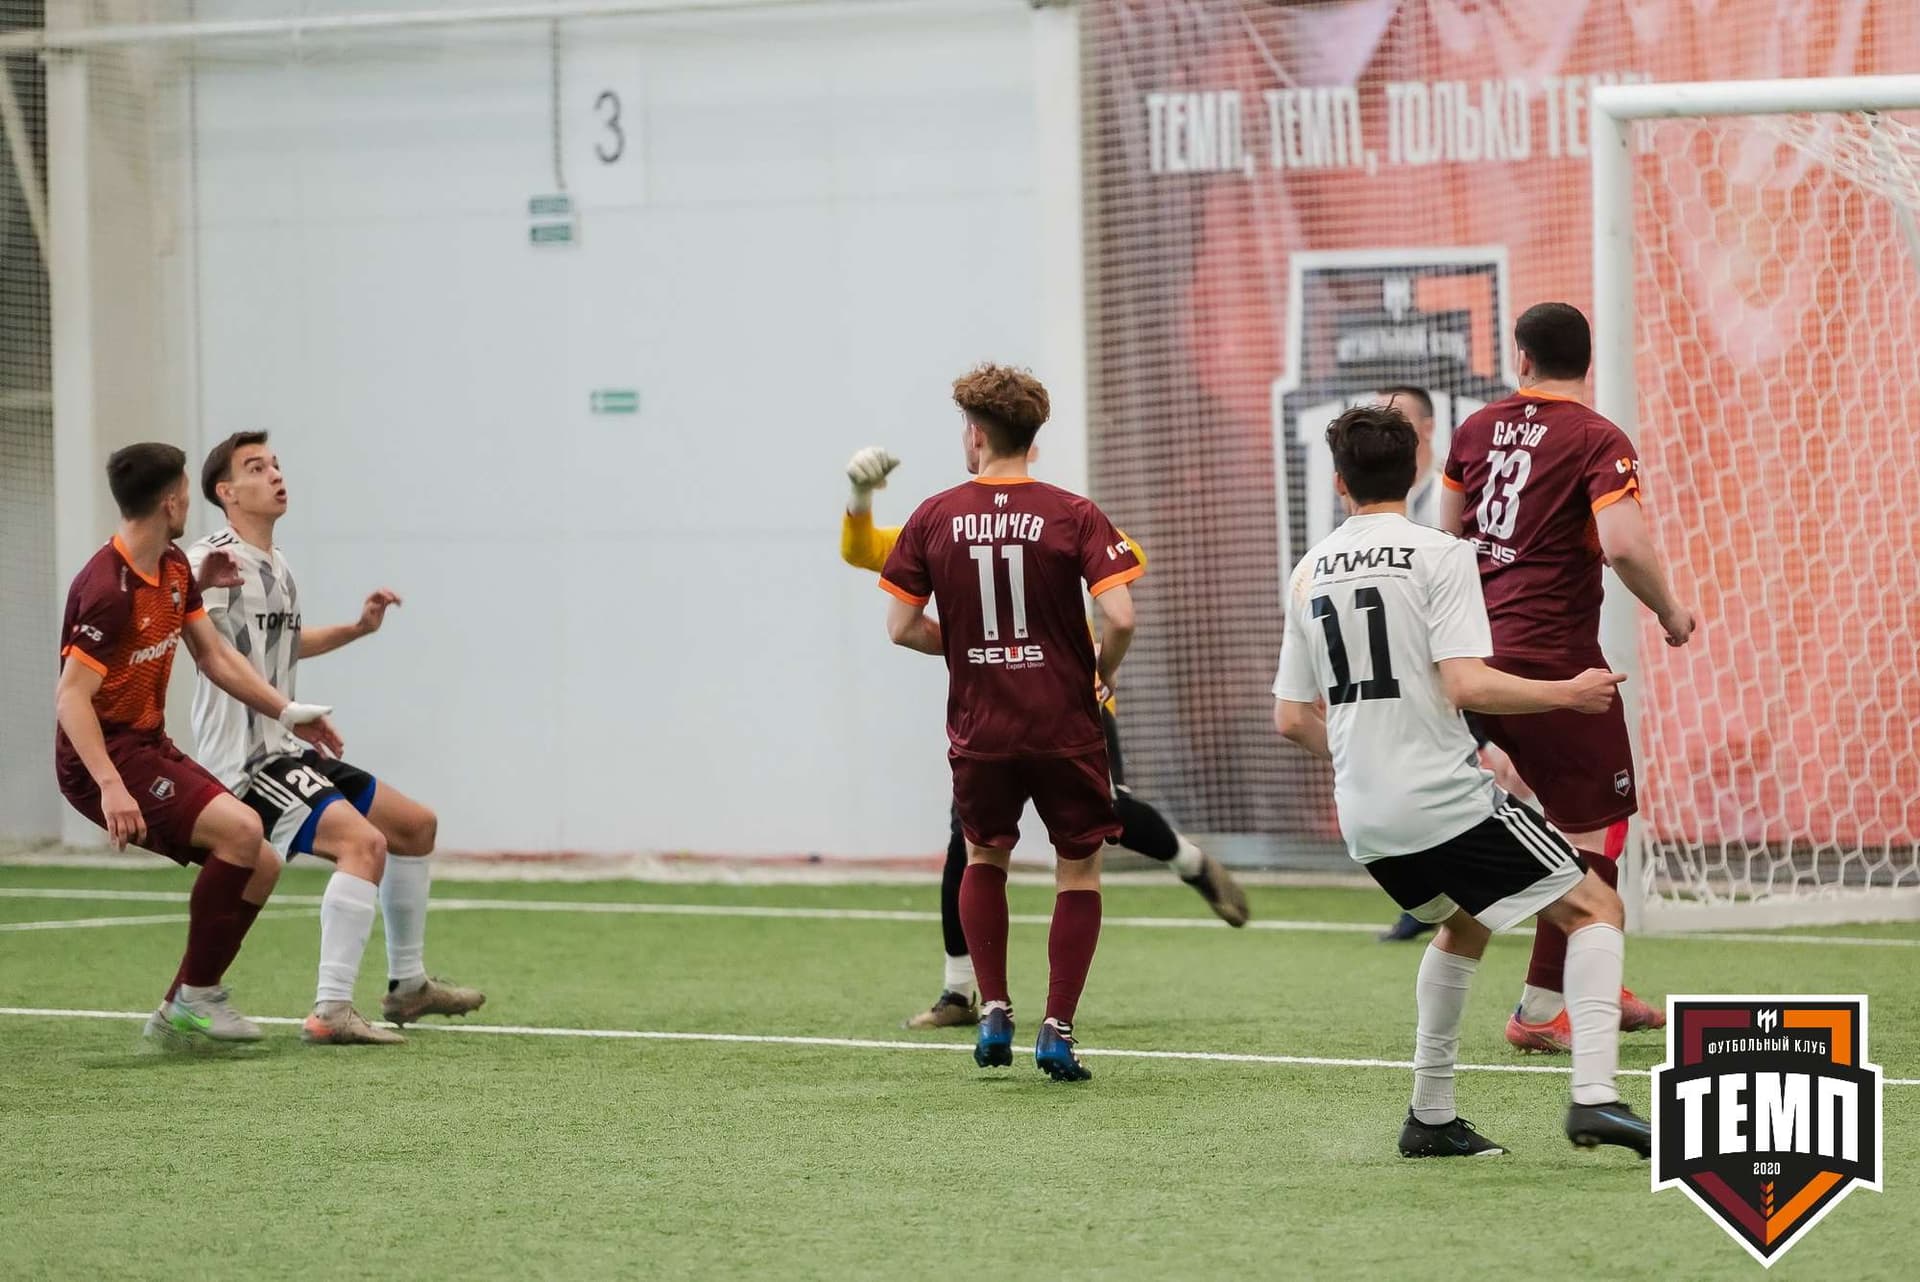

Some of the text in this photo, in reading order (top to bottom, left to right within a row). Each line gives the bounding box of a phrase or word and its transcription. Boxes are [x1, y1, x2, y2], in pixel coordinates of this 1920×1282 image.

[595, 91, 625, 163] 3
[1263, 86, 1378, 177] ТЕМП,
[1384, 80, 1530, 166] ТОЛЬКО
[952, 513, 1045, 543] РОДИЧЕВ
[1476, 449, 1531, 540] 13
[969, 544, 1029, 641] 11
[1313, 546, 1416, 580] АЛМАЗ
[967, 645, 1044, 664] SEUS
[1311, 586, 1402, 706] 11
